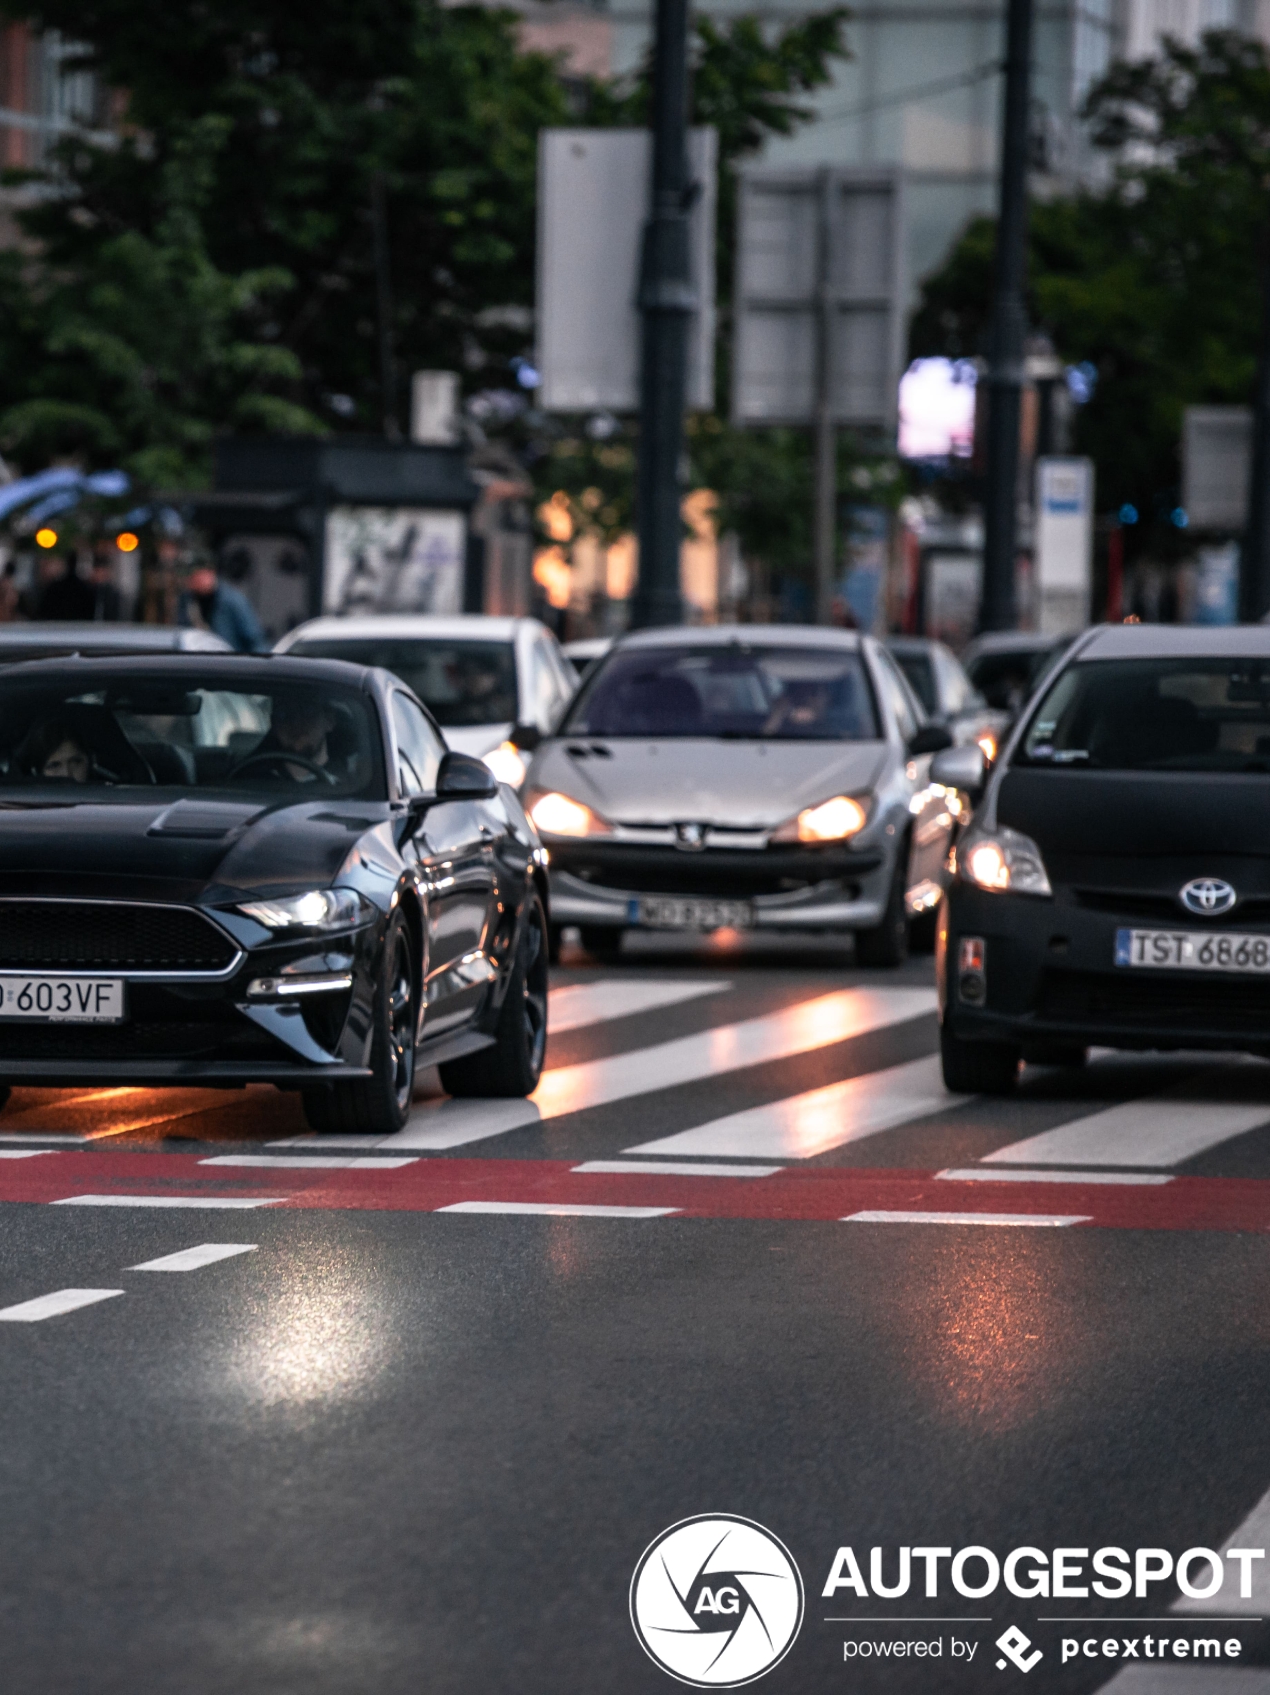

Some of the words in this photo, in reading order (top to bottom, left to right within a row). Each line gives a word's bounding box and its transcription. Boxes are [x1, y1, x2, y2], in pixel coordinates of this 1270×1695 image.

[1135, 934, 1188, 964] TST
[1199, 937, 1268, 967] 6868
[17, 982, 114, 1013] 603VF
